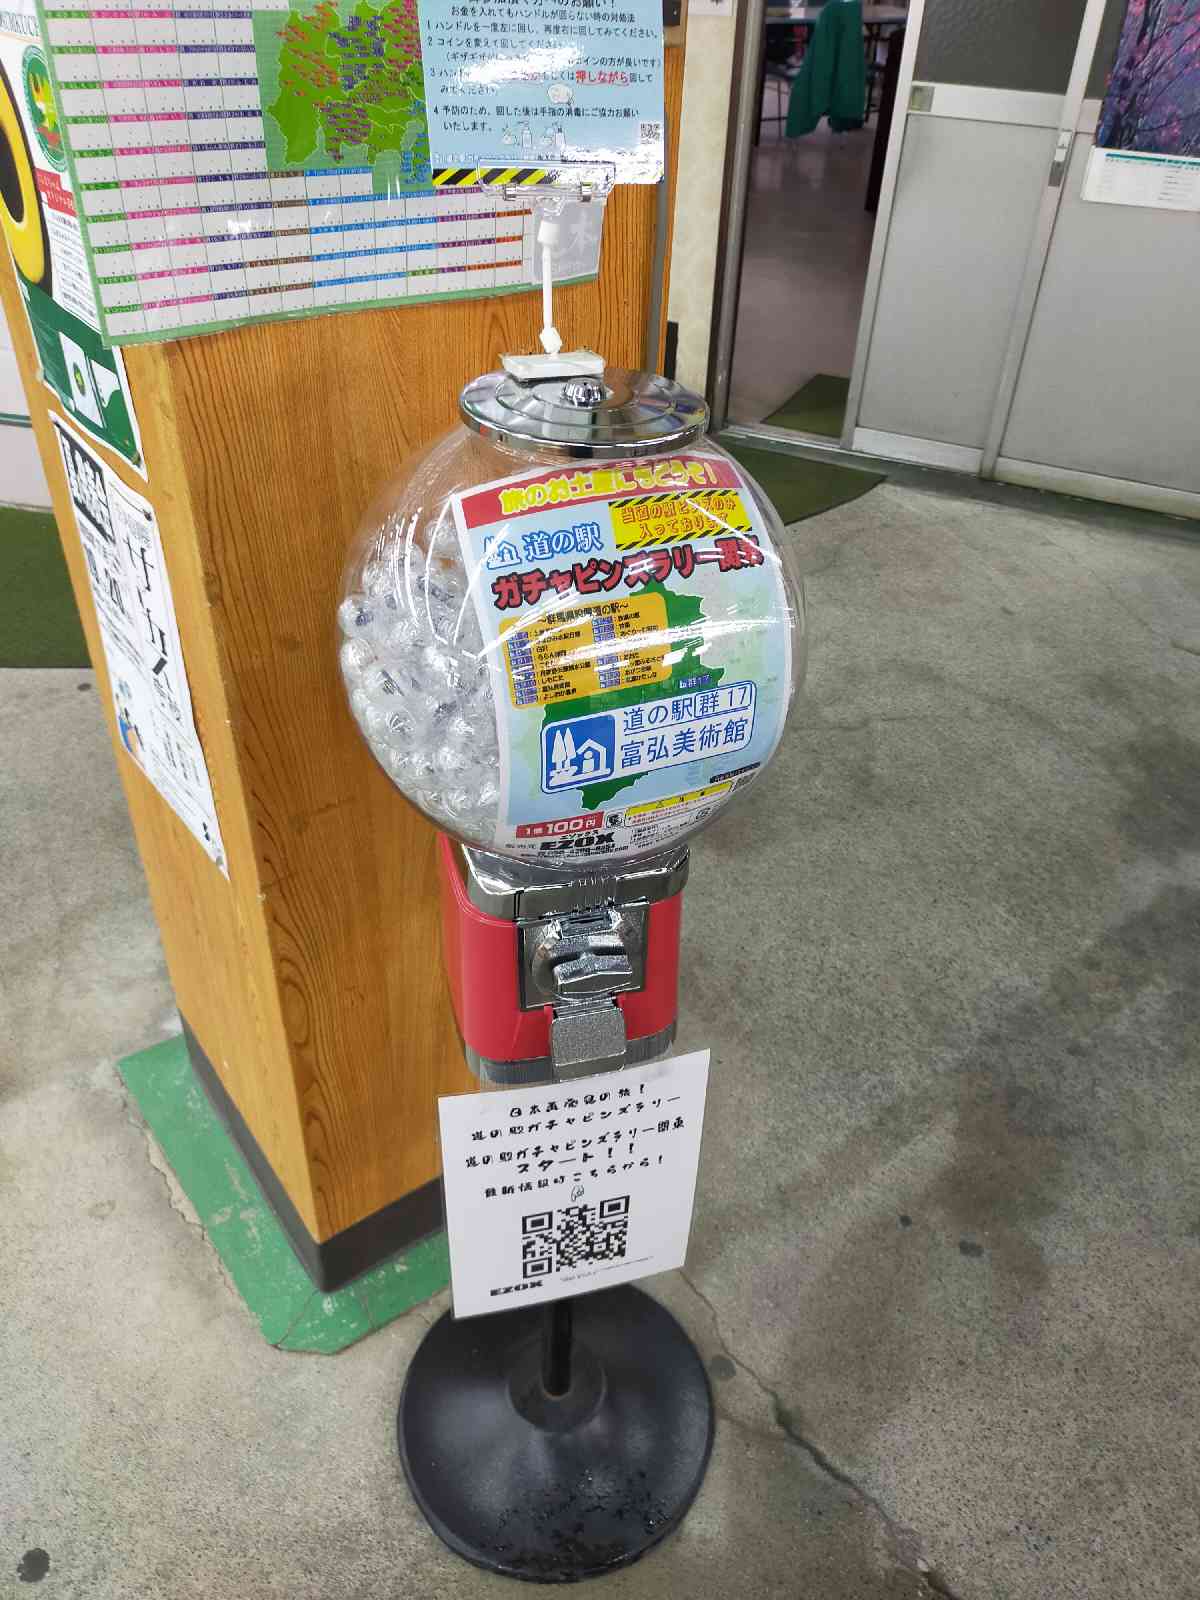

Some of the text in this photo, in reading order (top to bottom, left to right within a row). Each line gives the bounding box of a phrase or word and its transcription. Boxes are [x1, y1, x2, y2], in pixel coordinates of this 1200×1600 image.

[525, 522, 604, 563] 道の駅
[624, 698, 693, 732] 道の駅
[620, 717, 749, 769] 富弘美術館
[540, 831, 615, 850] EZOX
